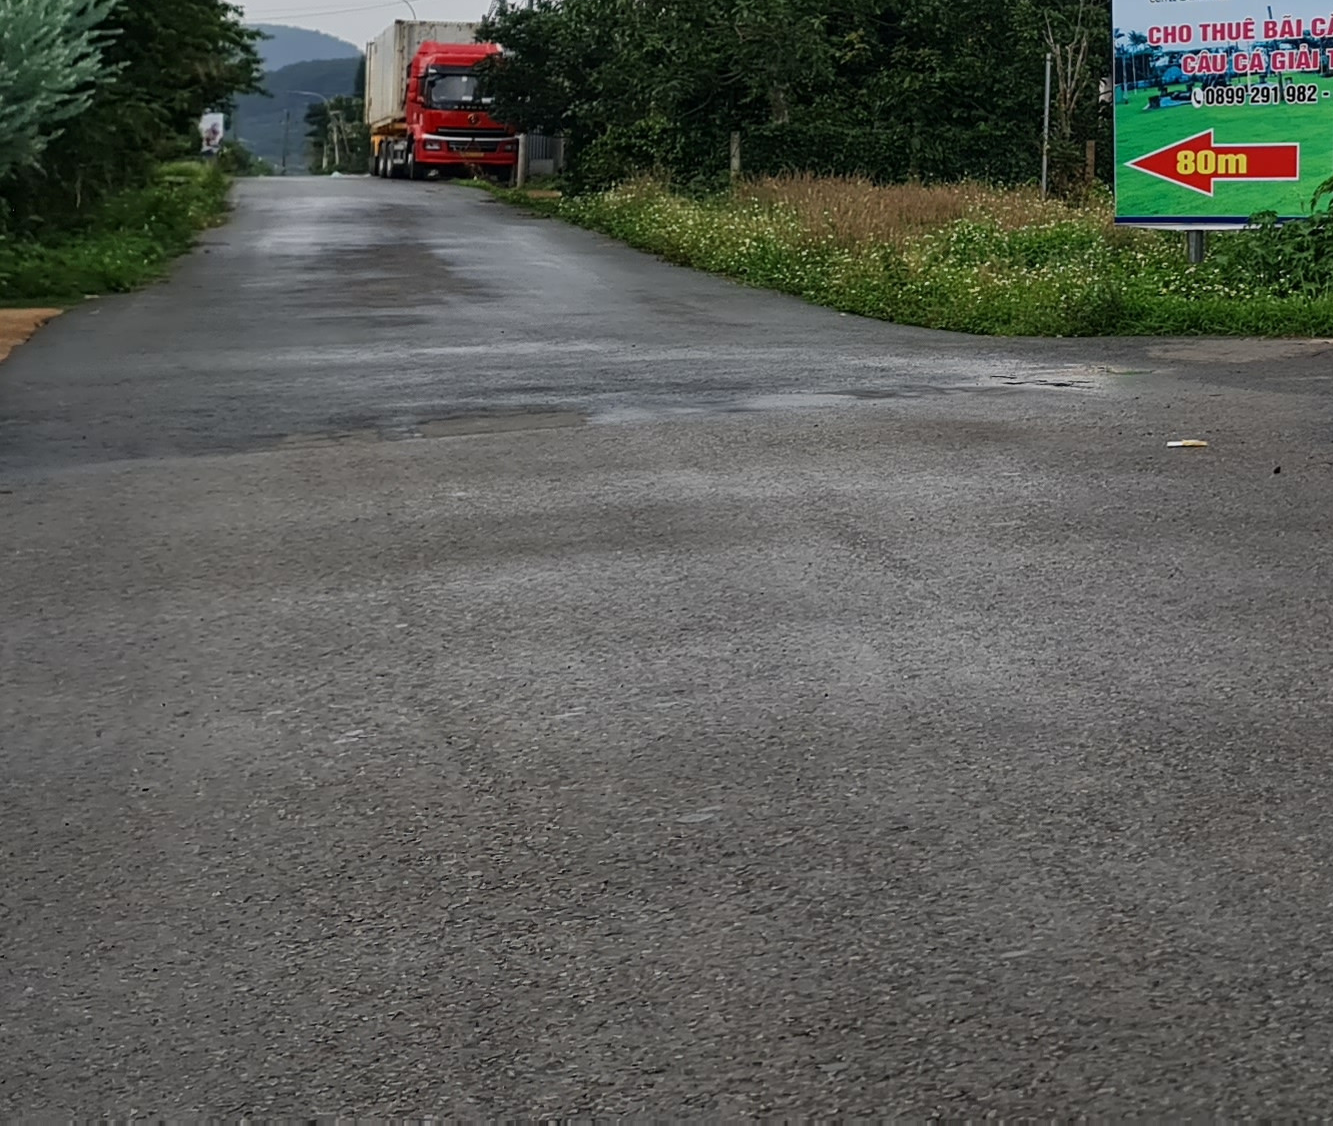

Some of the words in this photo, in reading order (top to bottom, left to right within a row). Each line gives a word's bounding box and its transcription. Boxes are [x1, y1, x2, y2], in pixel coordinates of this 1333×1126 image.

[1147, 24, 1193, 45] CHO
[1199, 17, 1255, 42] THUÊ
[1263, 14, 1302, 39] BÃI
[1181, 50, 1227, 74] CÂU
[1233, 48, 1264, 72] CÁ
[1271, 44, 1320, 71] GIẢI
[1205, 86, 1245, 105] 0899
[1250, 85, 1279, 104] 291
[1286, 84, 1318, 103] 982
[1175, 148, 1248, 176] 80m
